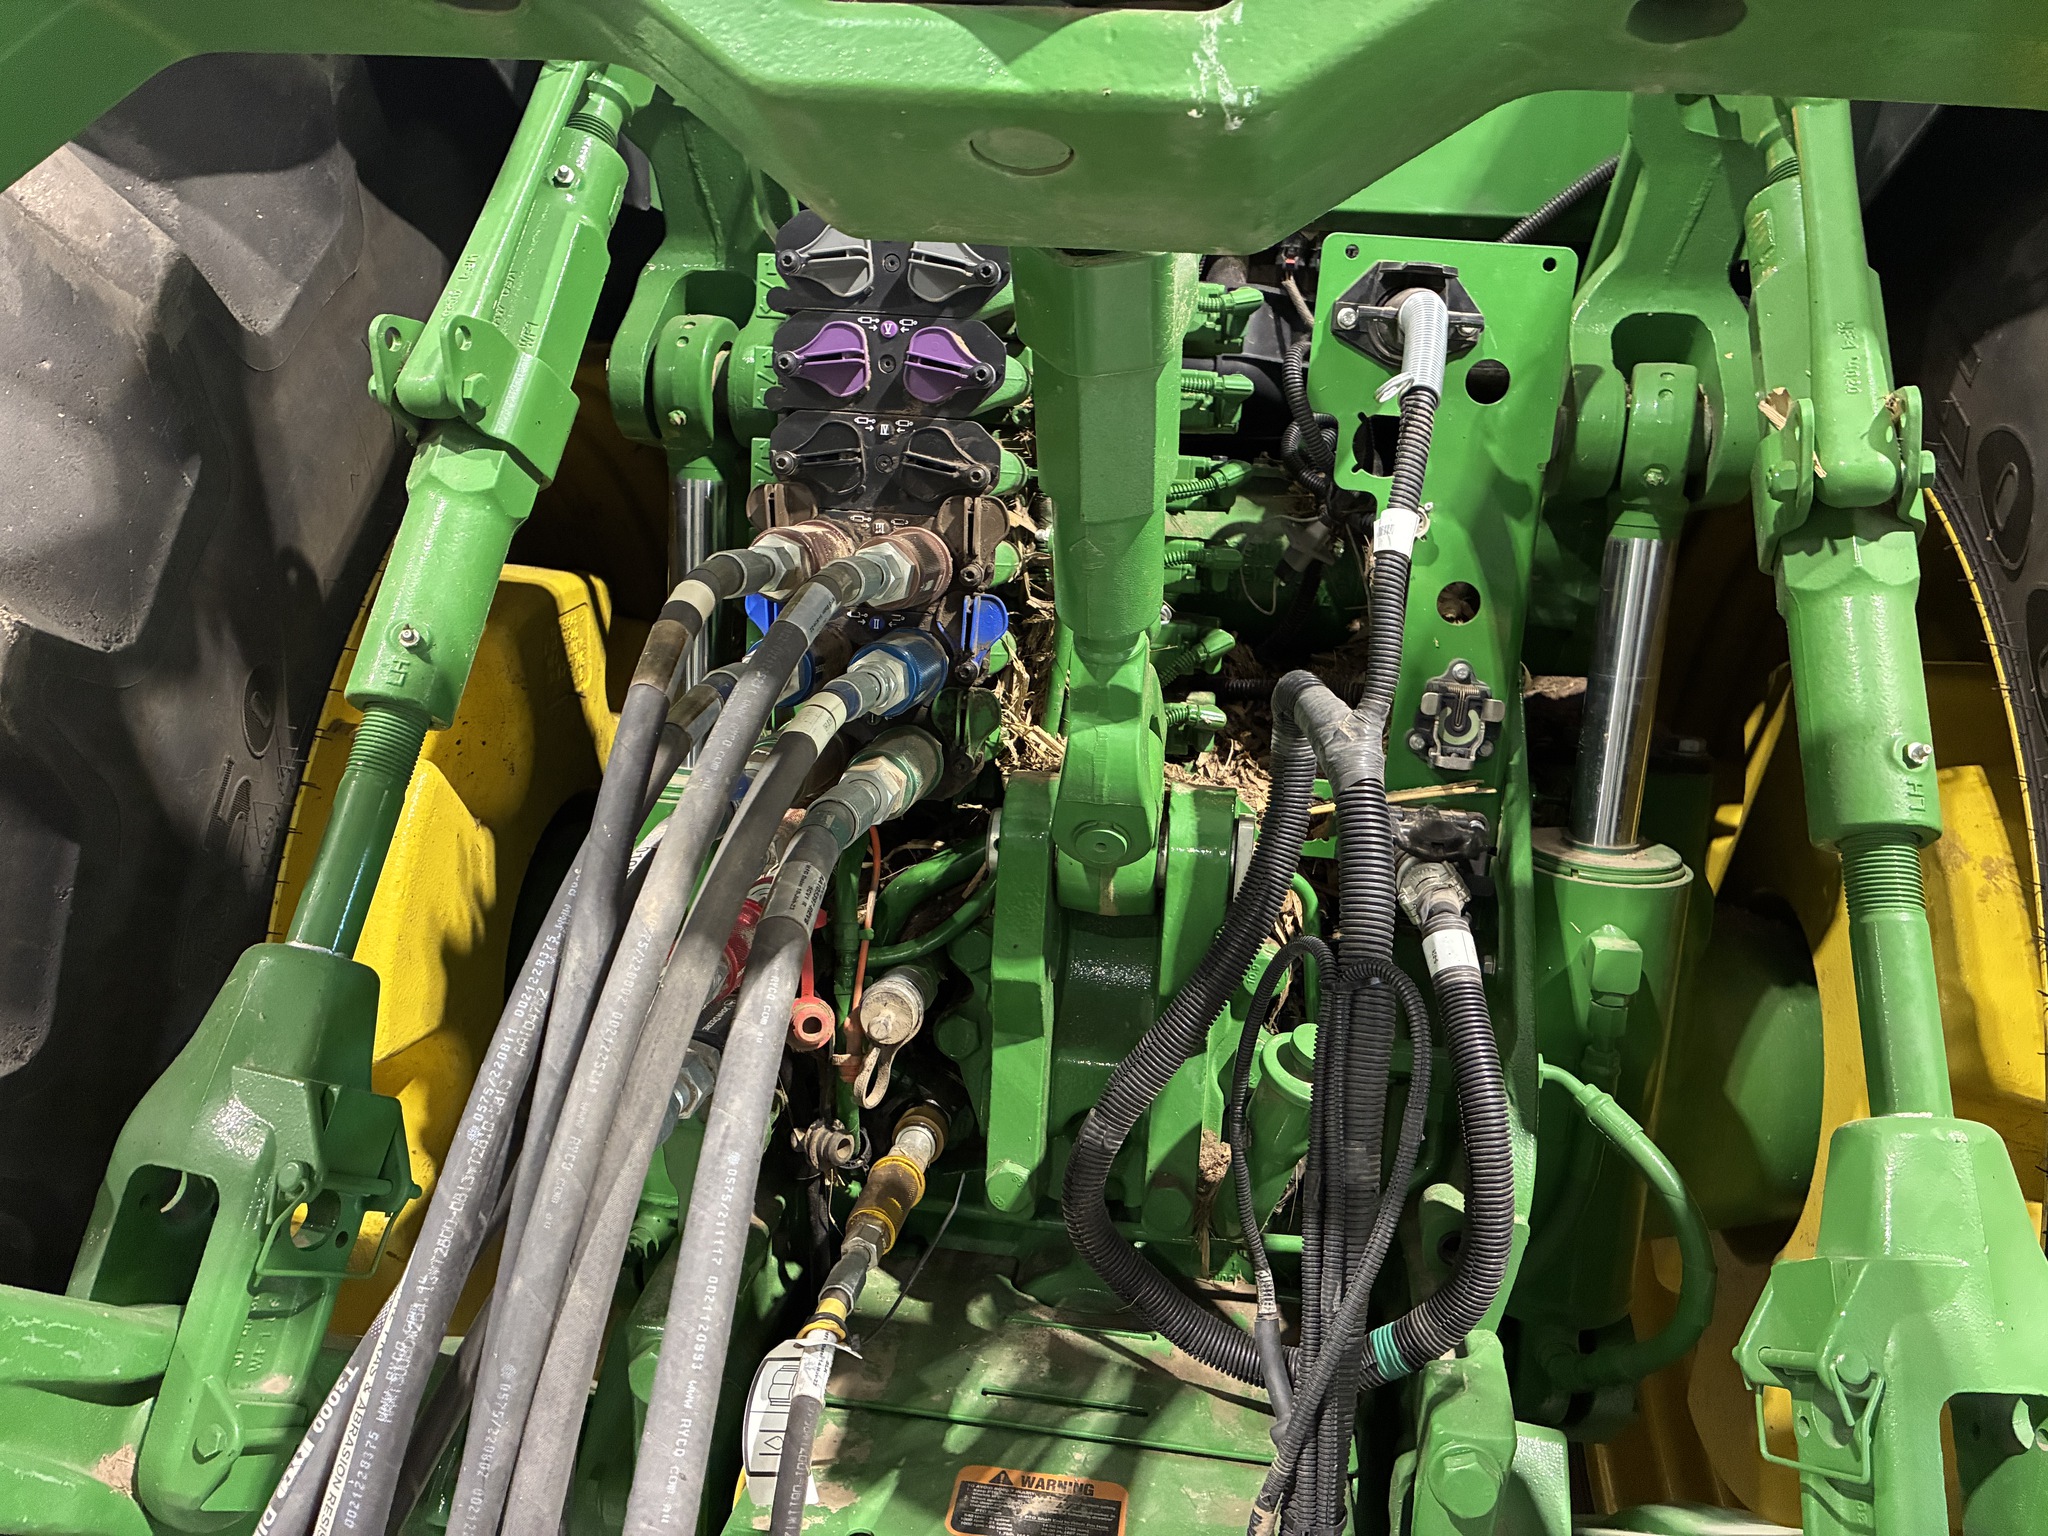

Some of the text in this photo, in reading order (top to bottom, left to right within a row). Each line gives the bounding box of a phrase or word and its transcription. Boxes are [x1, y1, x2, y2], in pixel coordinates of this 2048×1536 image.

[883, 323, 893, 335] V
[712, 1168, 738, 1266] 0575/211117
[312, 1366, 360, 1434] T3000
[331, 1401, 368, 1490] ABRASION
[344, 1430, 380, 1529] 0021228375
[1020, 1474, 1095, 1497] WARNING
